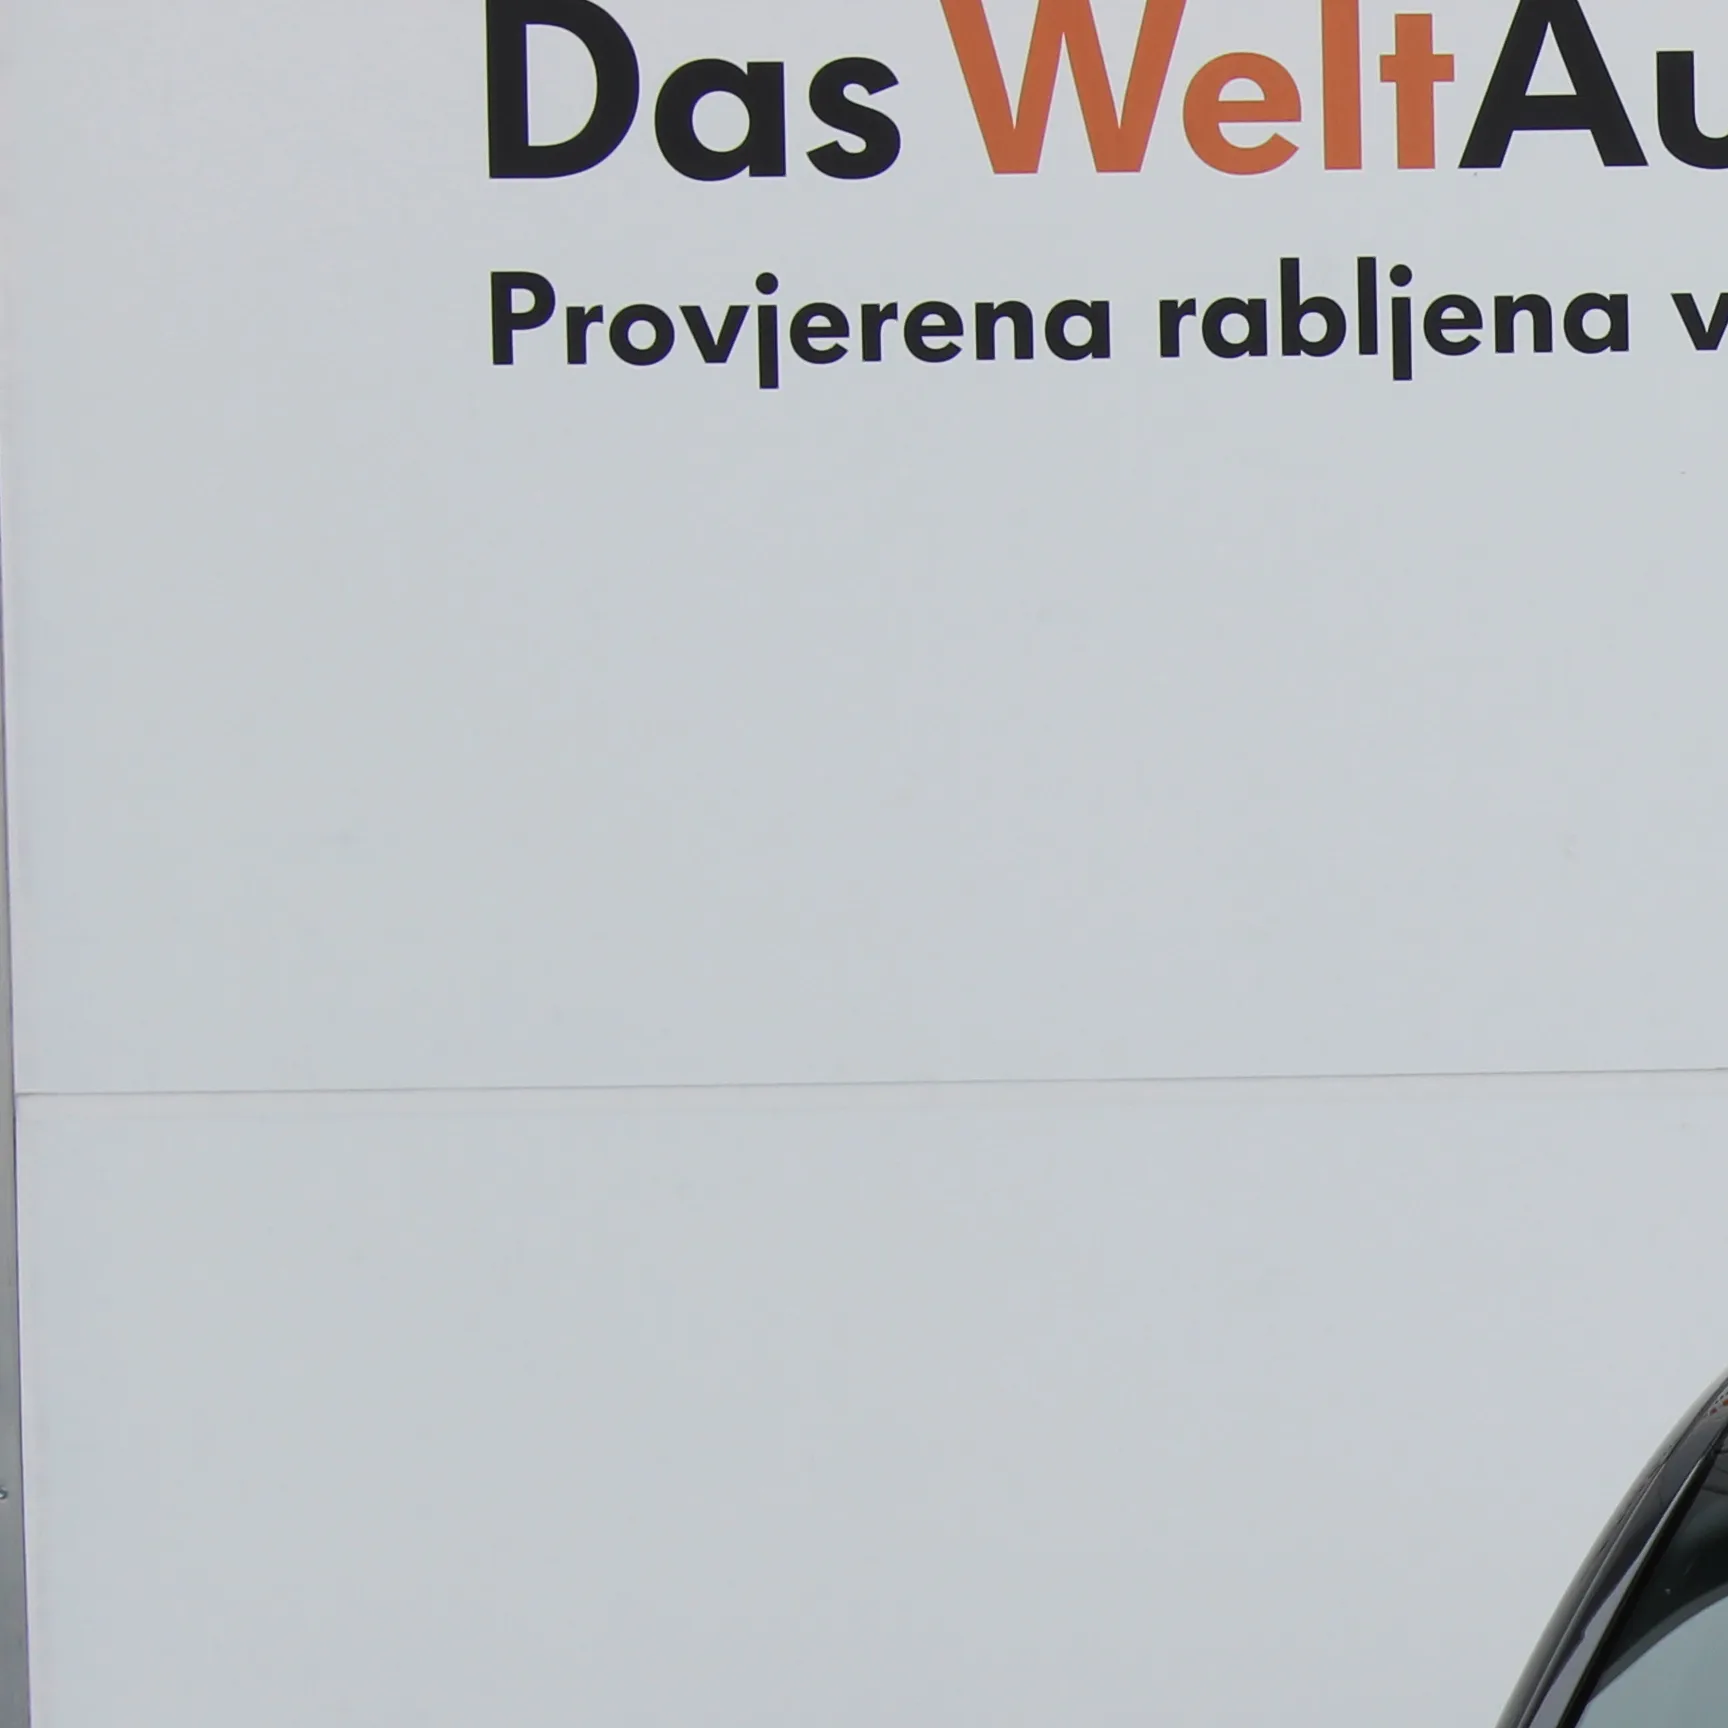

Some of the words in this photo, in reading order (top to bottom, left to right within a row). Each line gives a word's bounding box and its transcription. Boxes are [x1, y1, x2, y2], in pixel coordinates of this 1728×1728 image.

[486, 0, 900, 181] Das
[490, 272, 1111, 389] Provjerena
[1159, 257, 1629, 381] rabljena
